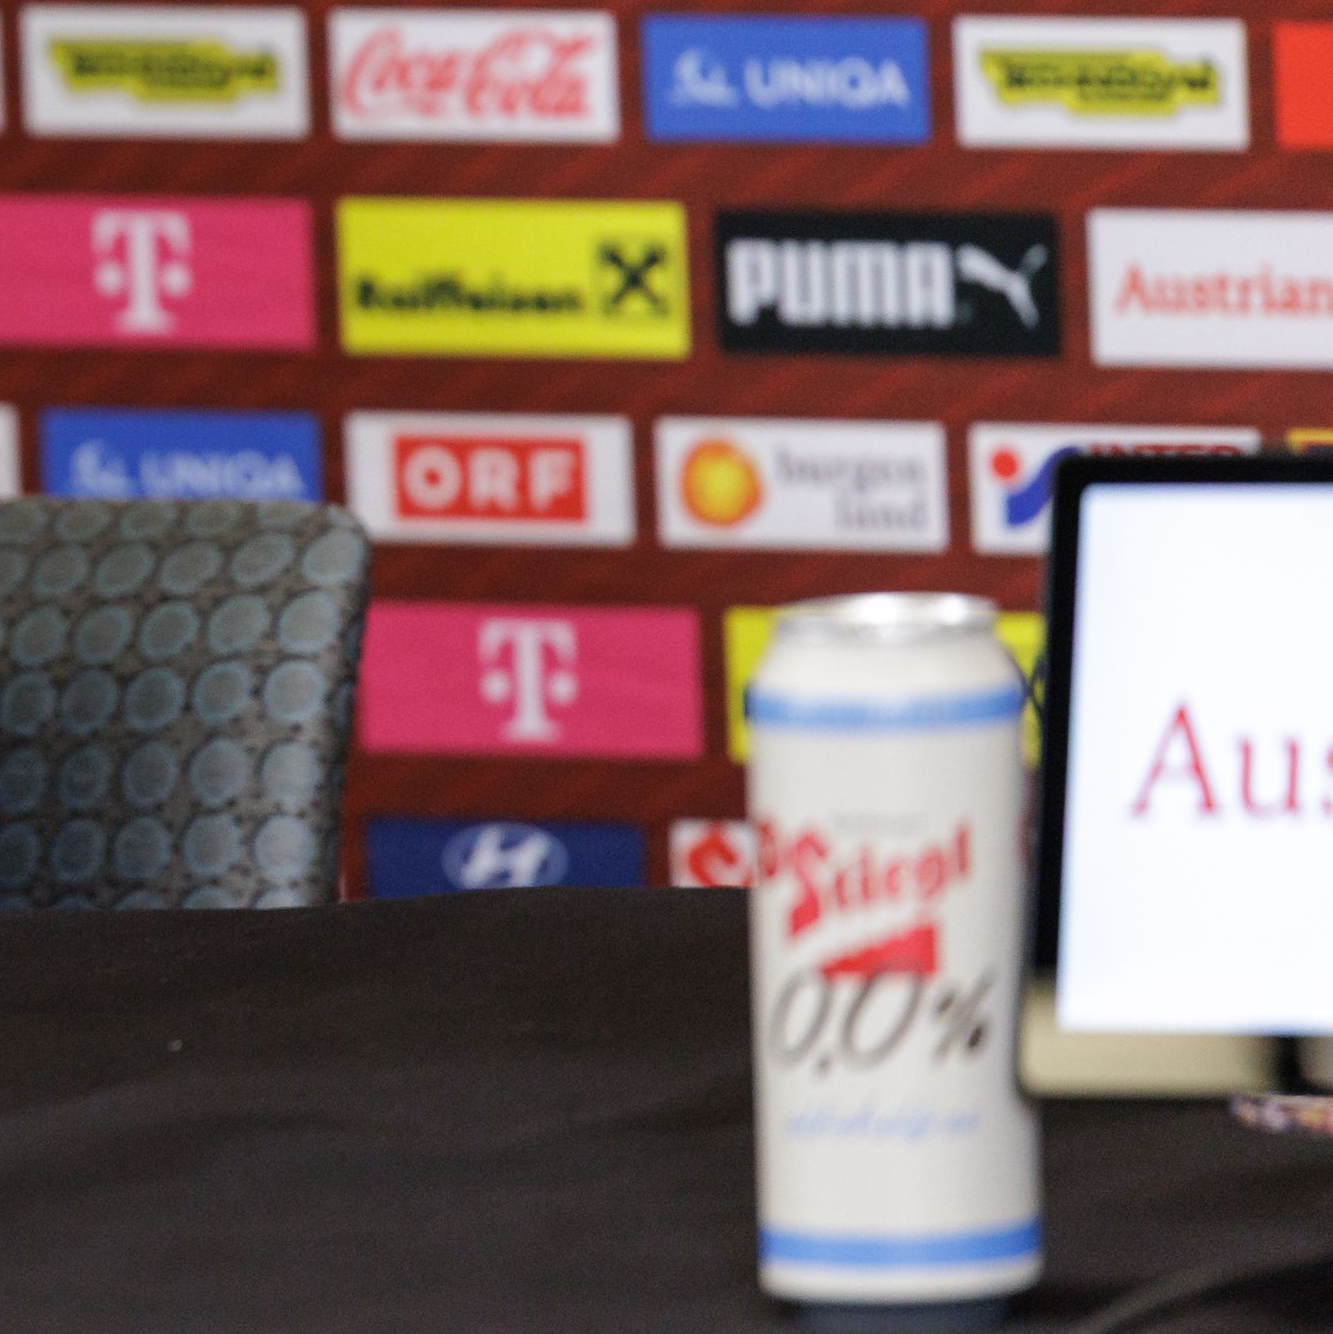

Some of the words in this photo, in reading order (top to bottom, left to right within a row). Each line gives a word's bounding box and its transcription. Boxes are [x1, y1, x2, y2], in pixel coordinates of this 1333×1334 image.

[341, 27, 593, 121] Coca-Cola
[745, 58, 910, 108] UNIQA
[727, 239, 957, 327] PUMA
[404, 447, 573, 508] ORF
